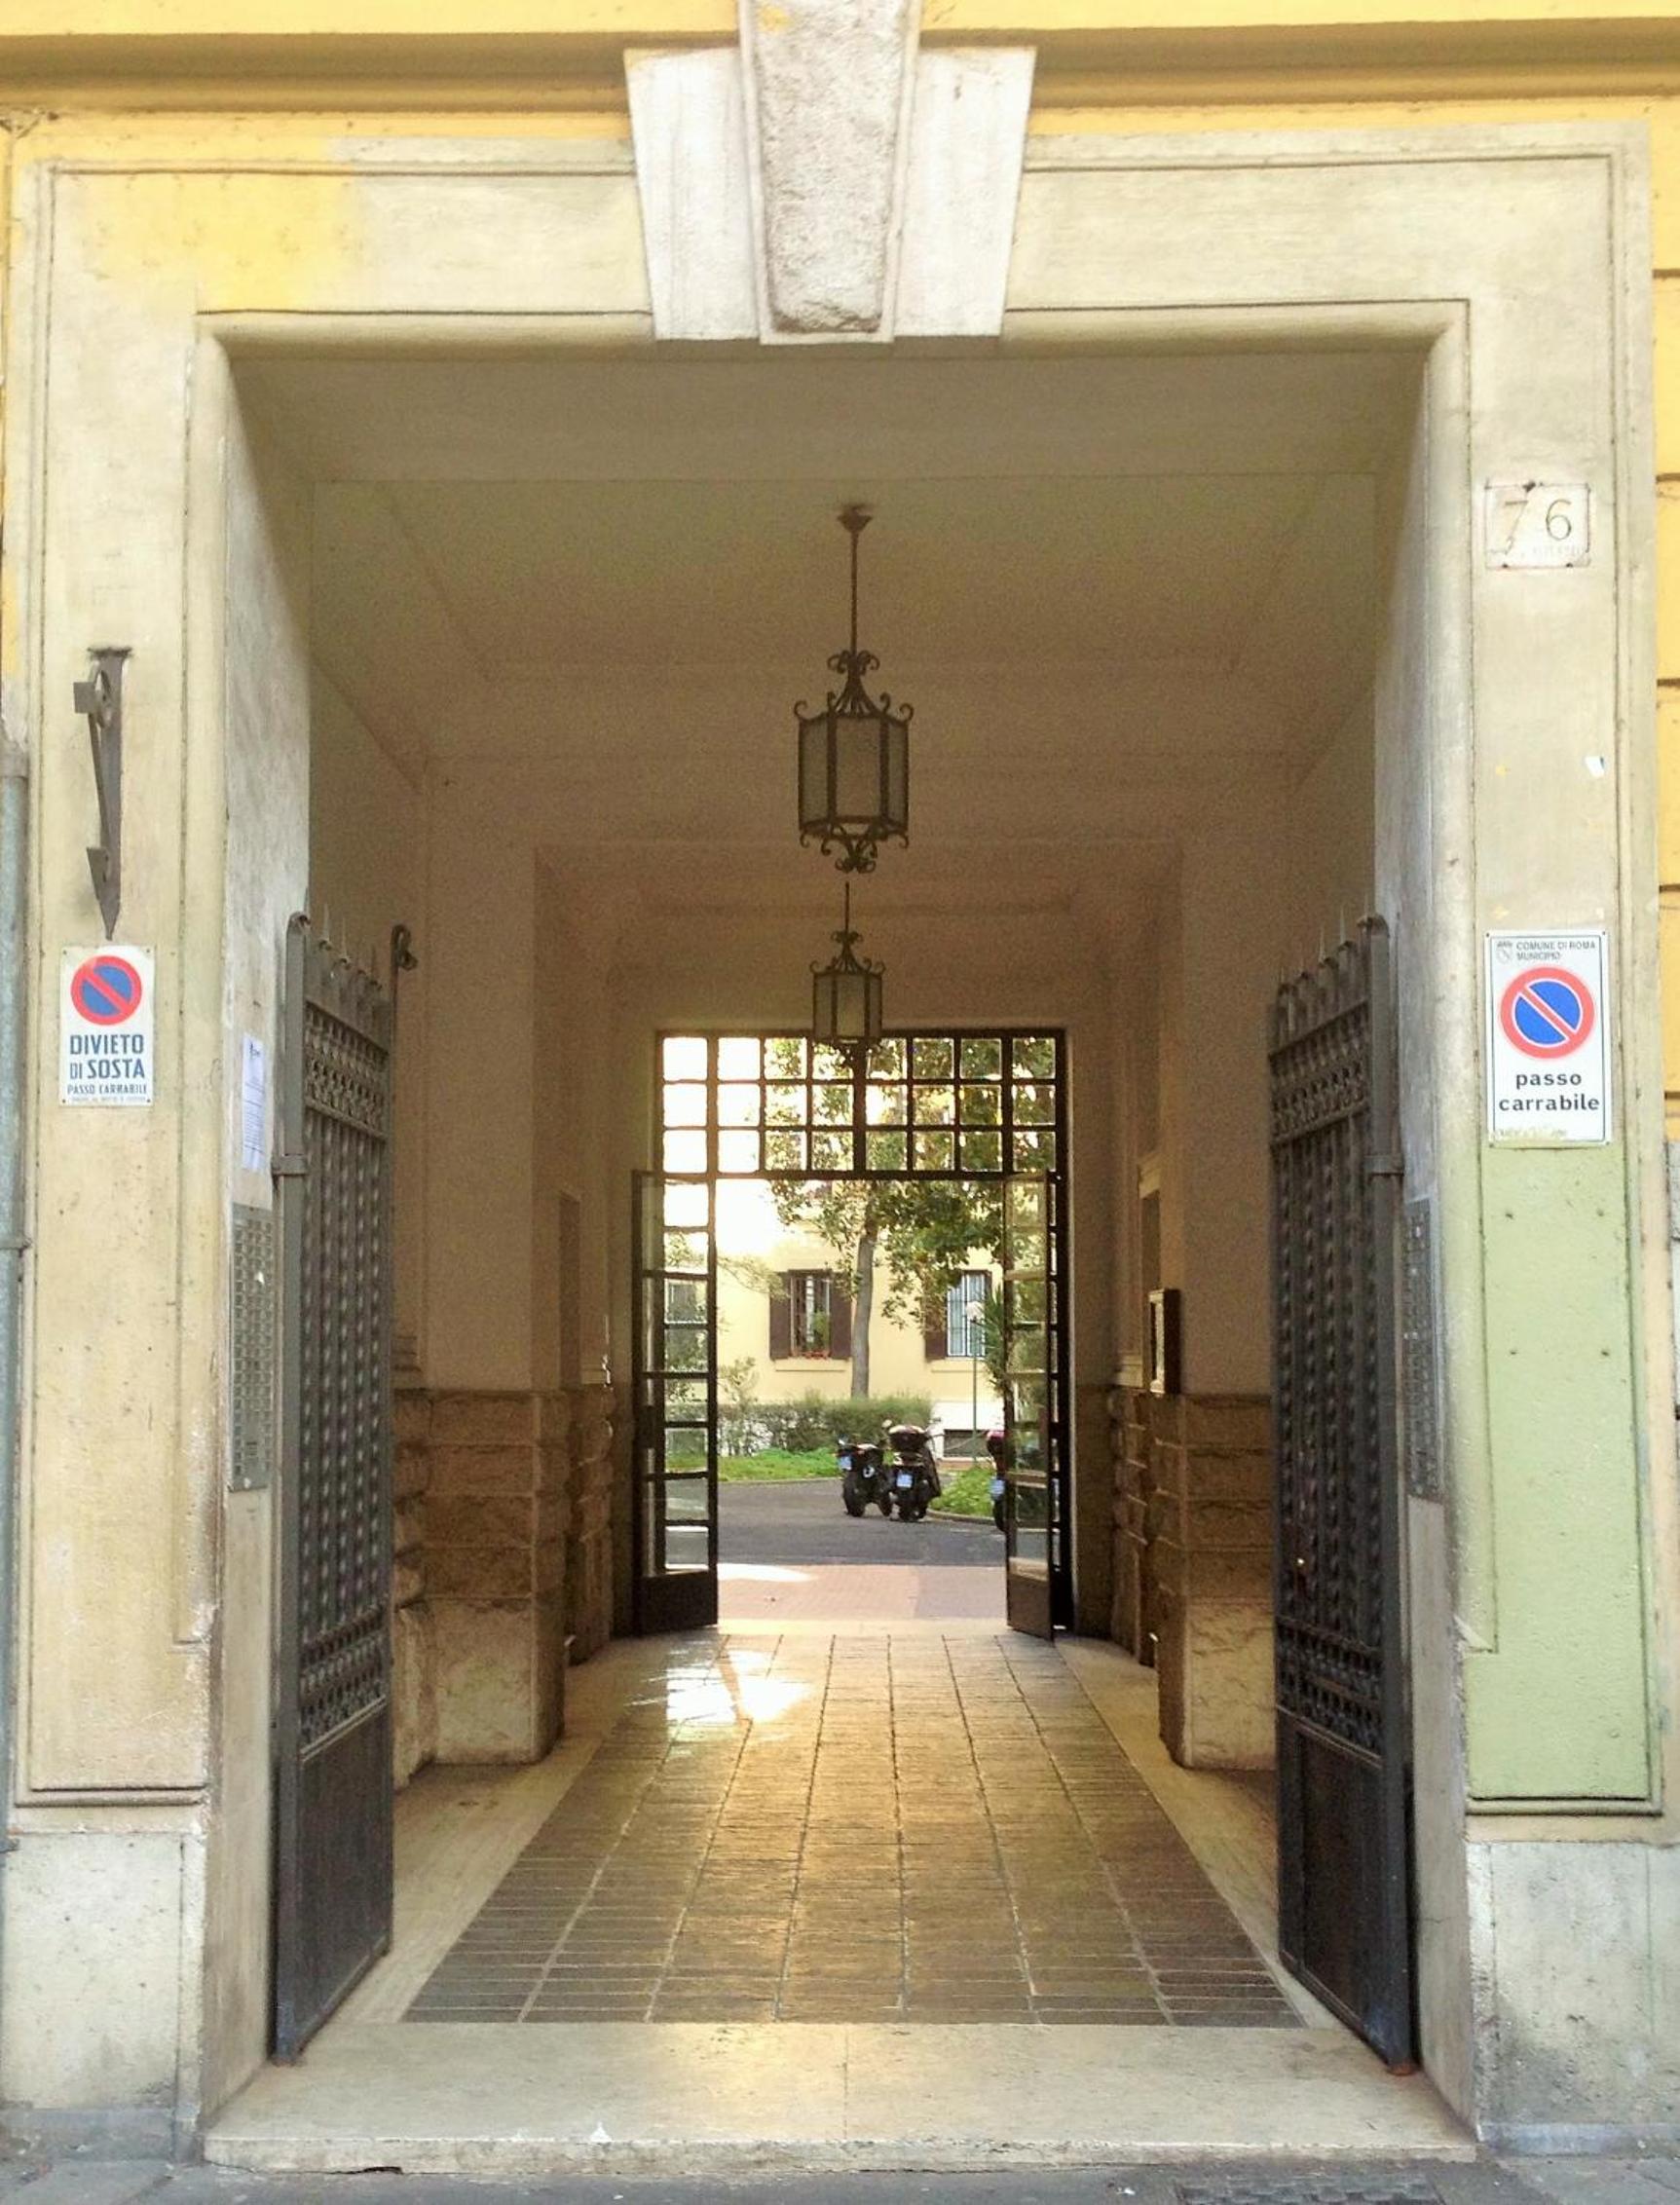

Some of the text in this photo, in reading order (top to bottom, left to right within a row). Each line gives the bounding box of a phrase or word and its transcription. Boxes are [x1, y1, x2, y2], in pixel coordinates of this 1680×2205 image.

[1504, 498, 1572, 545] 76
[1516, 941, 1555, 951] COMUNE
[1569, 941, 1595, 950] ROMA
[69, 1034, 144, 1055] DIVIETO
[70, 1058, 145, 1079] DI SOSTA
[67, 1084, 95, 1095] PASSO
[1515, 1073, 1582, 1090] passo
[1499, 1094, 1600, 1111] carrabile
